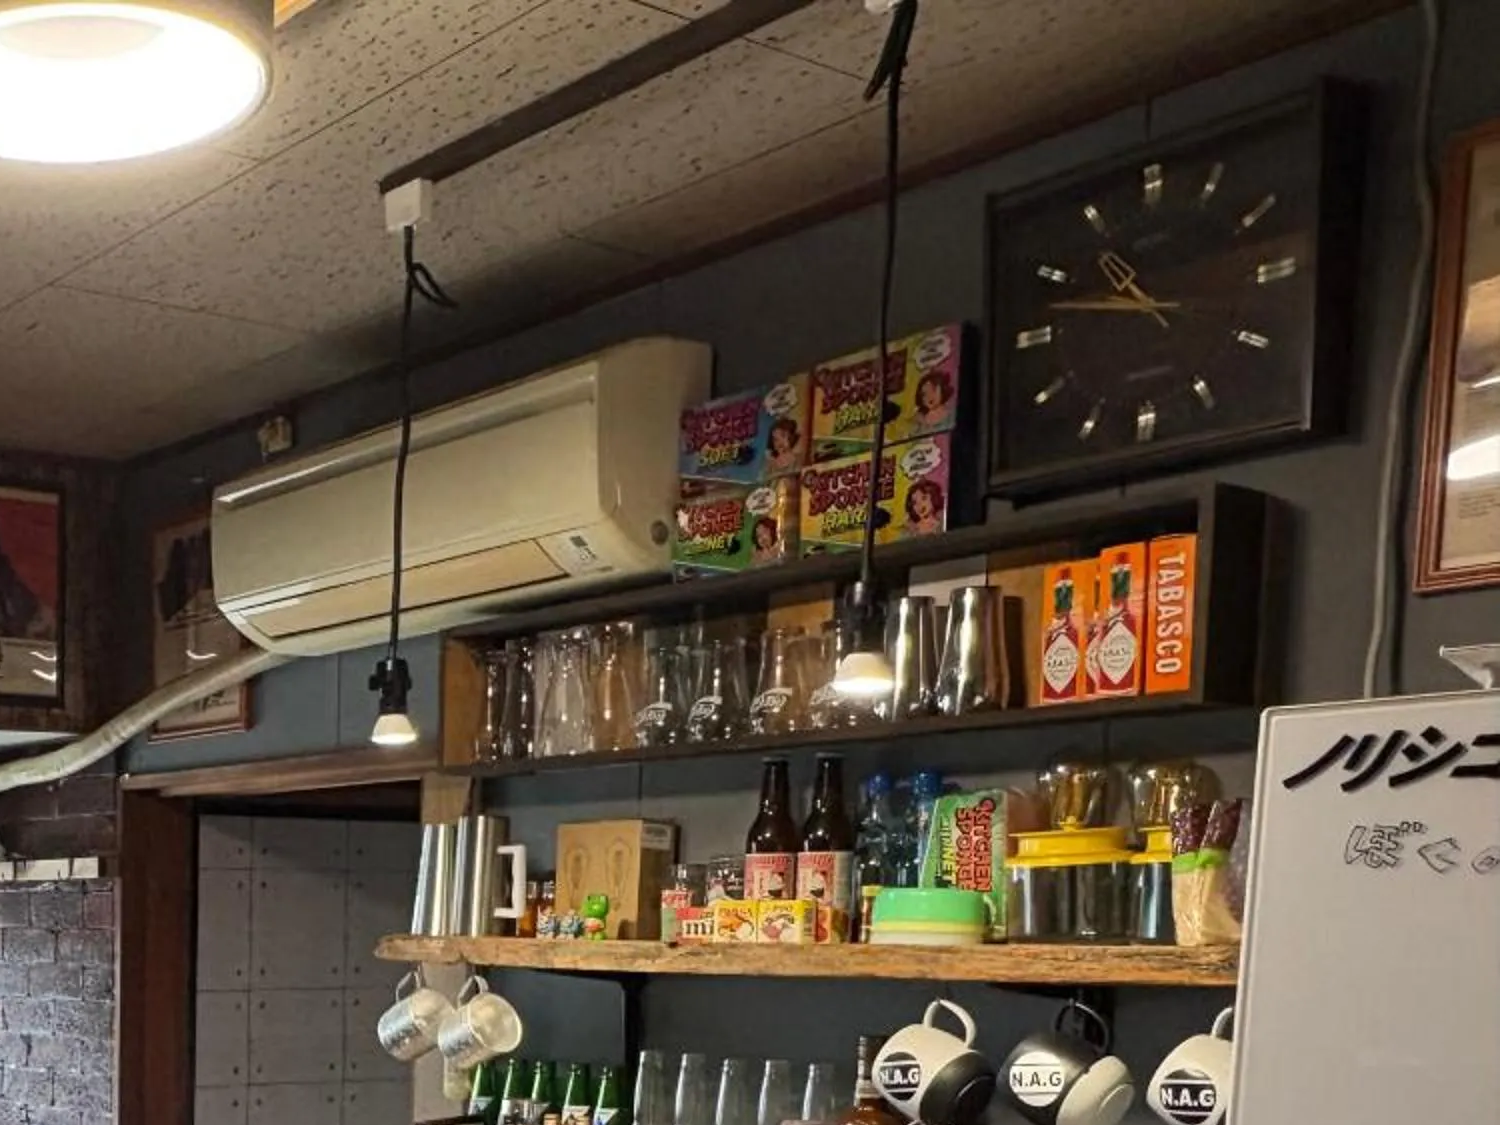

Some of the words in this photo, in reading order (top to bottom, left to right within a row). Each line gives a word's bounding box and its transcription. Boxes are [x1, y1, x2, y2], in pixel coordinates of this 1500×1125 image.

[803, 454, 897, 491] KITCHN
[809, 476, 895, 515] SPONE
[1155, 552, 1185, 674] TABASCO
[973, 800, 996, 892] KITCHEN
[880, 1066, 921, 1085] N.A.G
[1011, 1070, 1063, 1088] N.A.G
[1160, 1087, 1215, 1108] N.A.G
